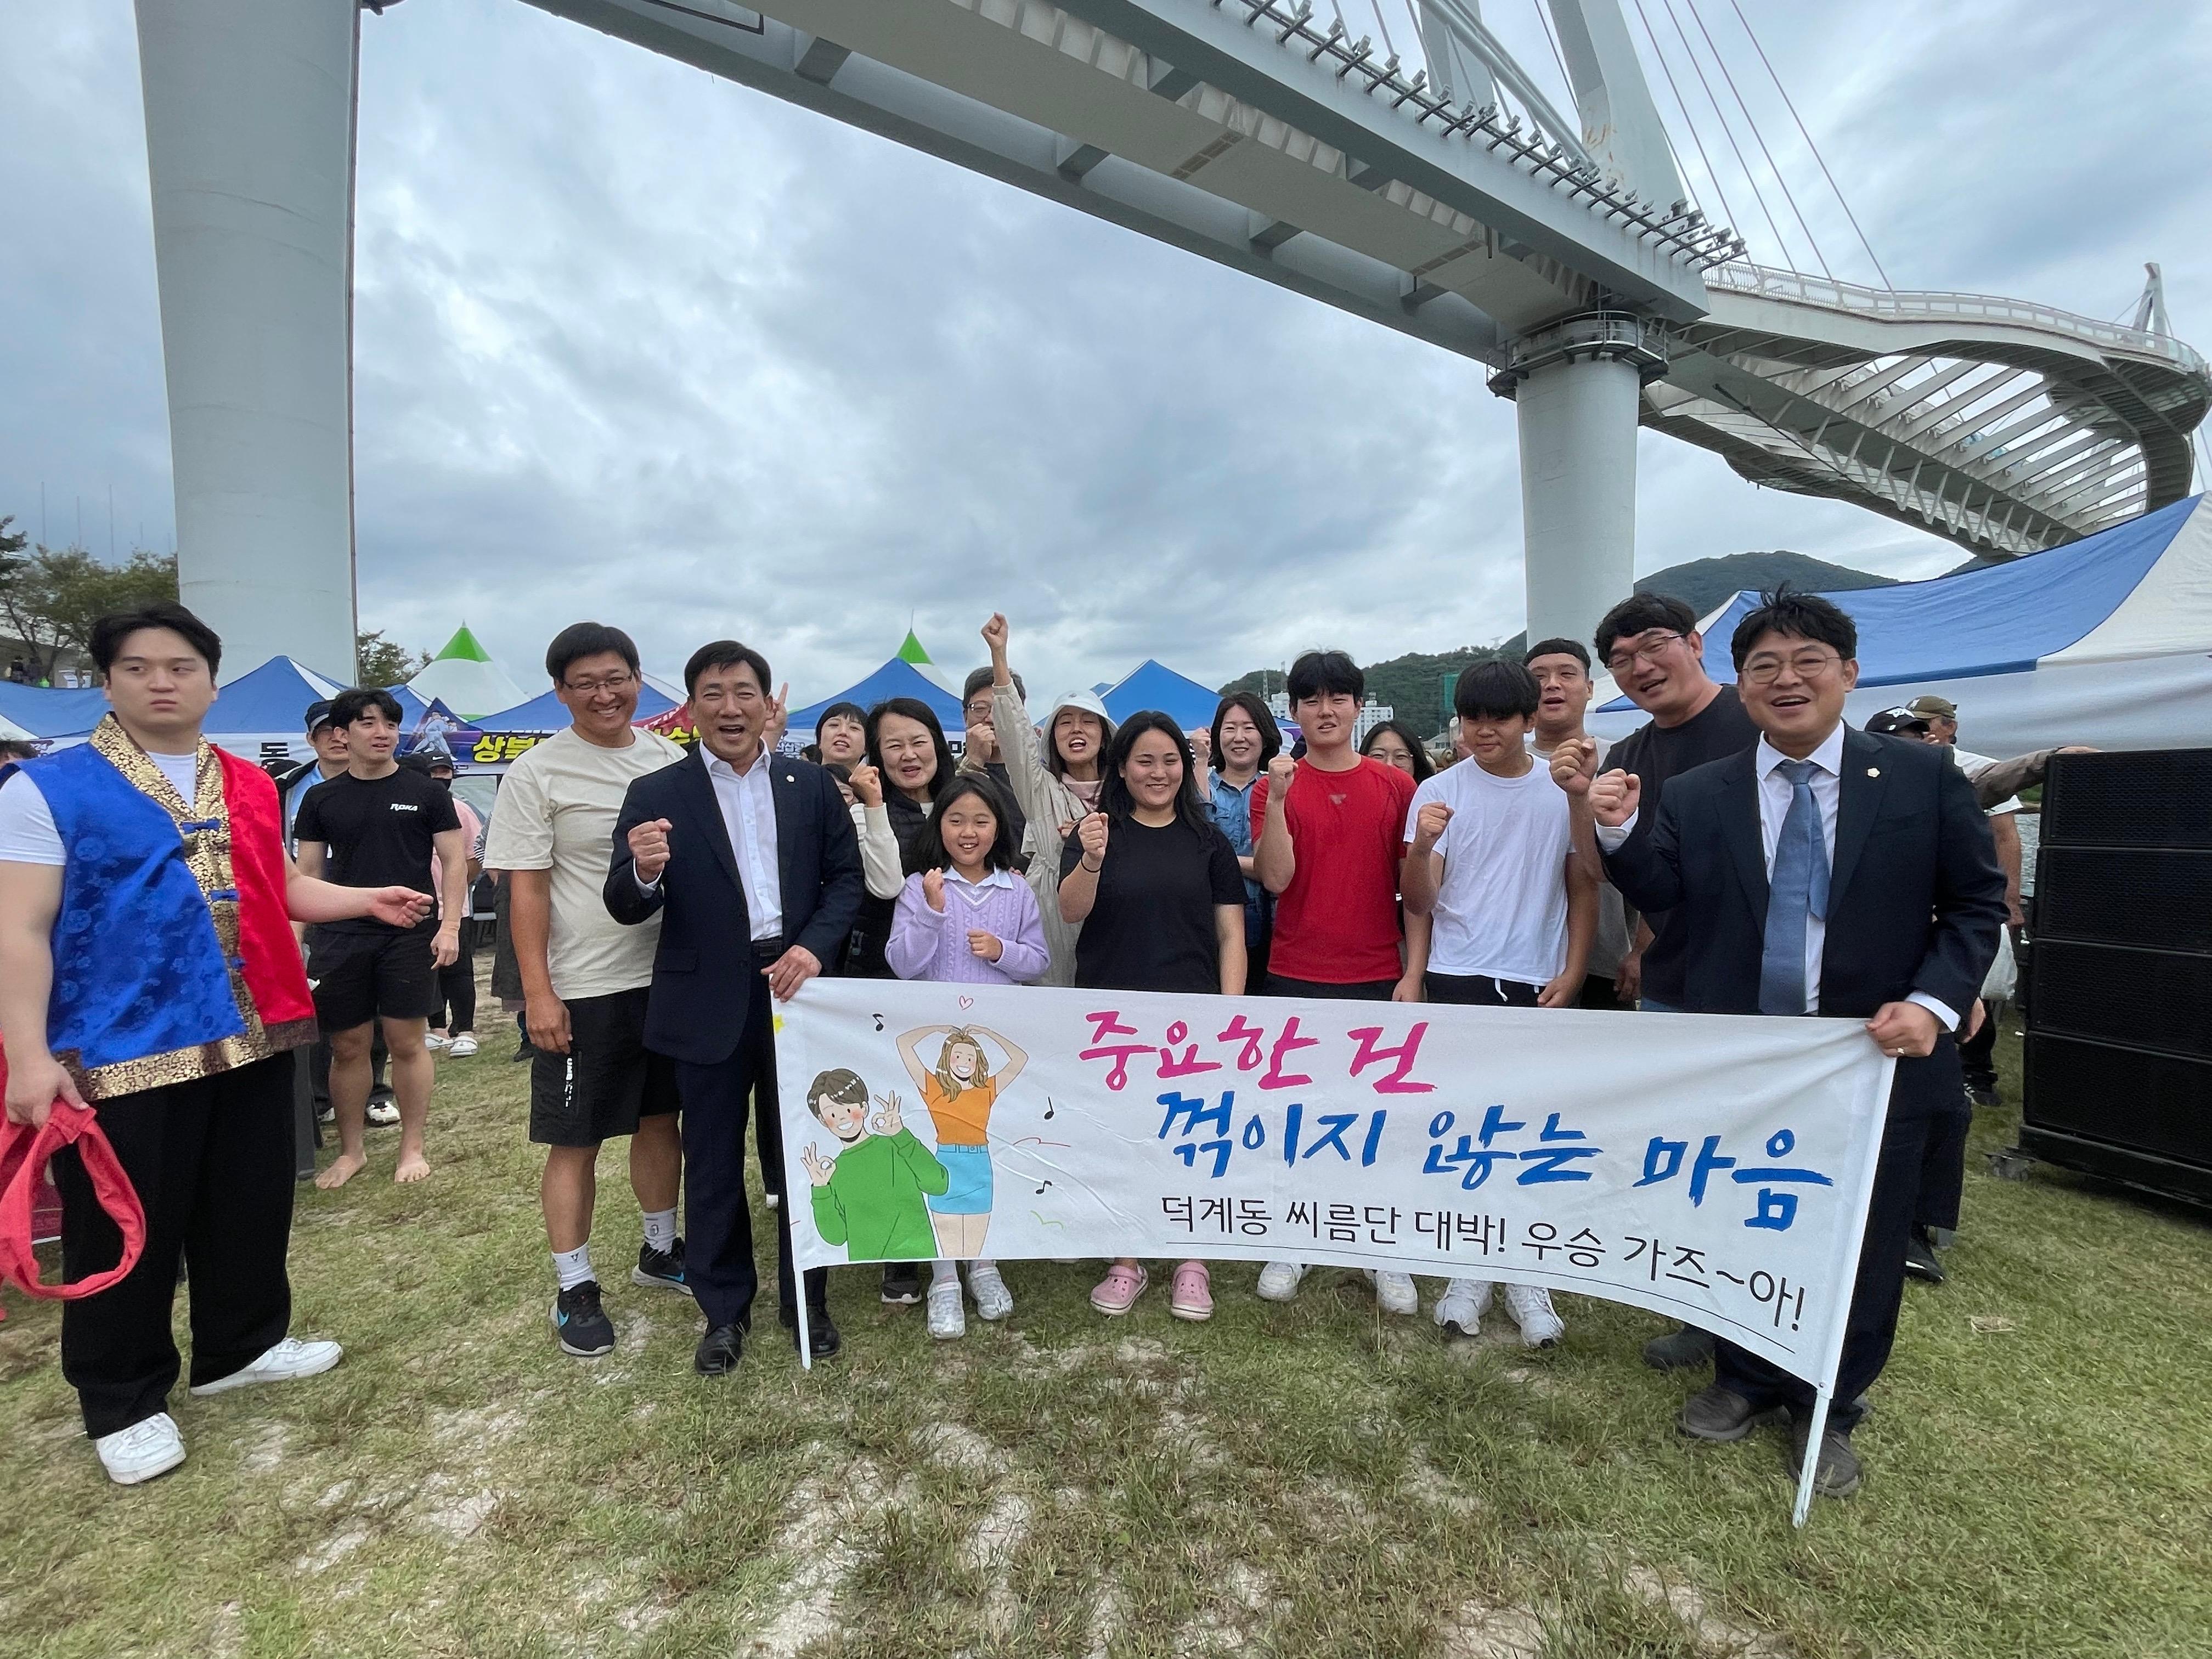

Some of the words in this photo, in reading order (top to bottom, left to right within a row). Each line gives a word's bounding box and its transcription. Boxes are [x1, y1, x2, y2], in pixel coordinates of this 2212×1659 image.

[390, 803, 418, 811] ROKA
[1079, 1011, 1318, 1090] 중요한
[1347, 1022, 1435, 1094] 건
[1156, 1091, 1386, 1178] 꺾이지
[1423, 1105, 1602, 1190] 않는
[1633, 1129, 1833, 1232] 마음
[1161, 1196, 1272, 1235] 덕계동
[1285, 1201, 1402, 1244] 씨름단
[1414, 1211, 1505, 1255] 대박!
[1521, 1222, 1606, 1267] 우승
[1623, 1237, 1805, 1332] 가즈~아!
